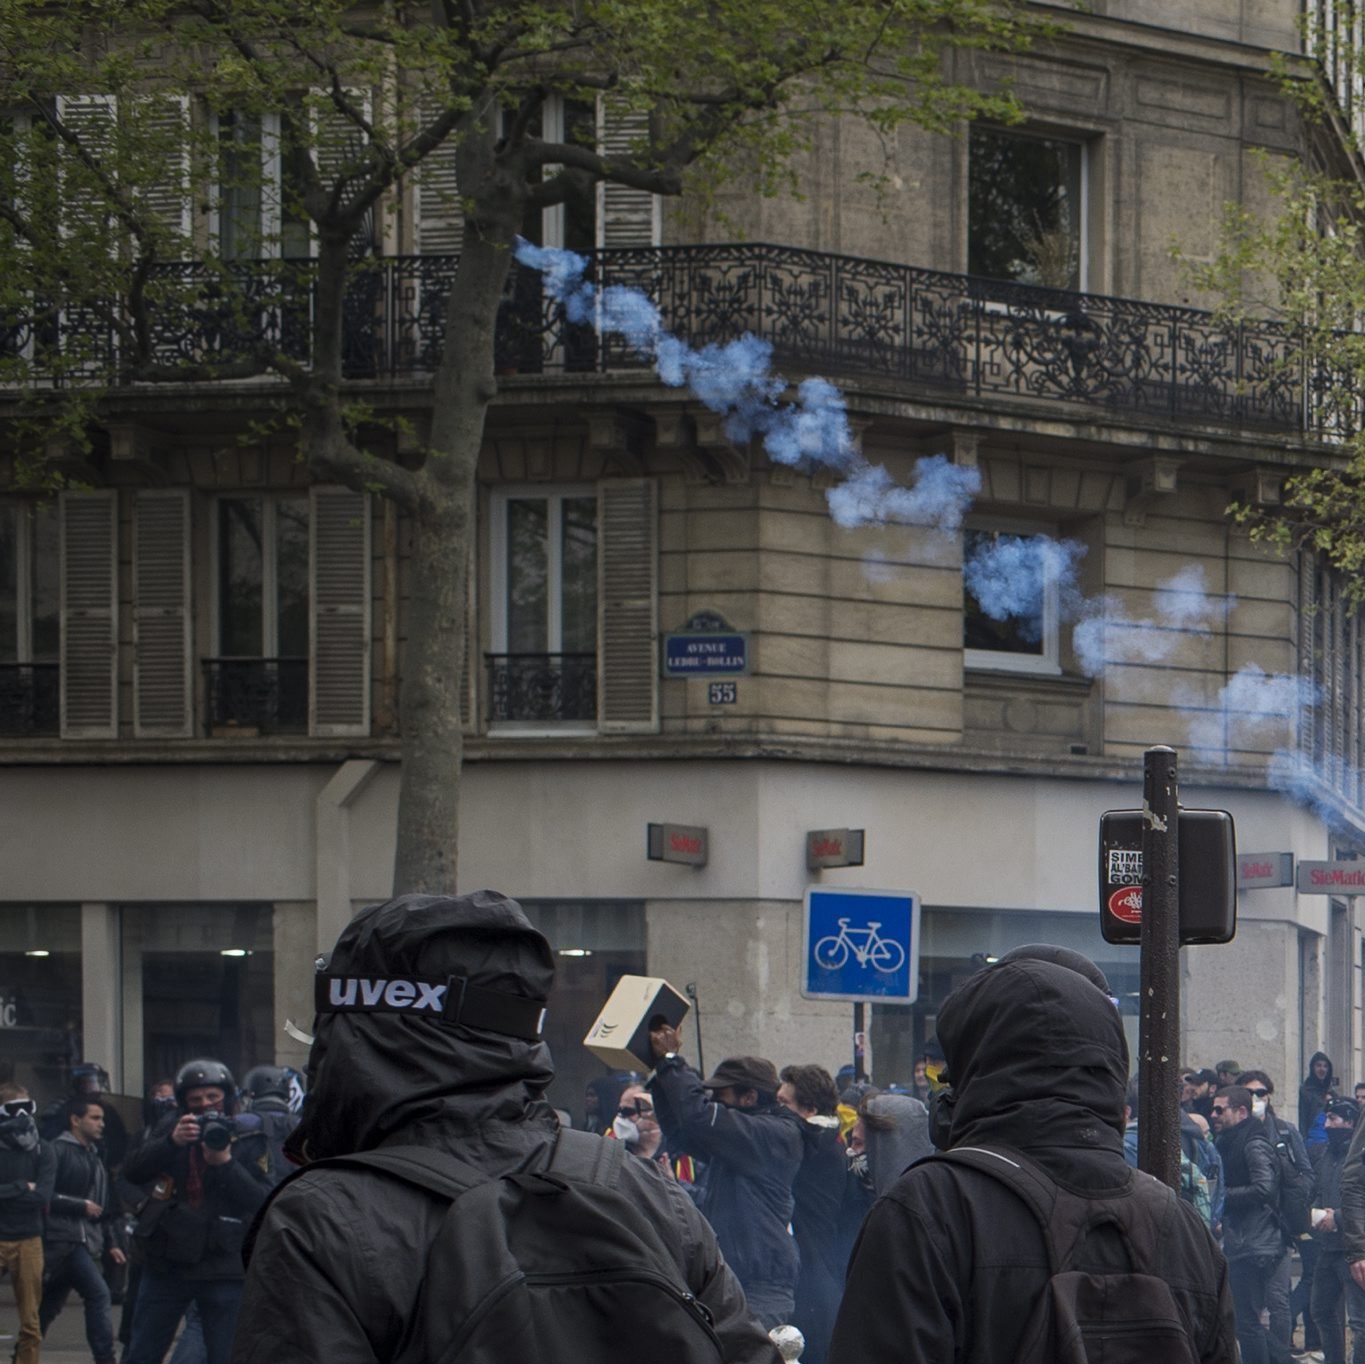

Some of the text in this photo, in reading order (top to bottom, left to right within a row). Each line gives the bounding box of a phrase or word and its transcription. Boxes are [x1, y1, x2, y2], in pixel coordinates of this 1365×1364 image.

[687, 643, 726, 653] AVENUE
[711, 684, 734, 703] 55
[329, 978, 448, 1012] uvex
